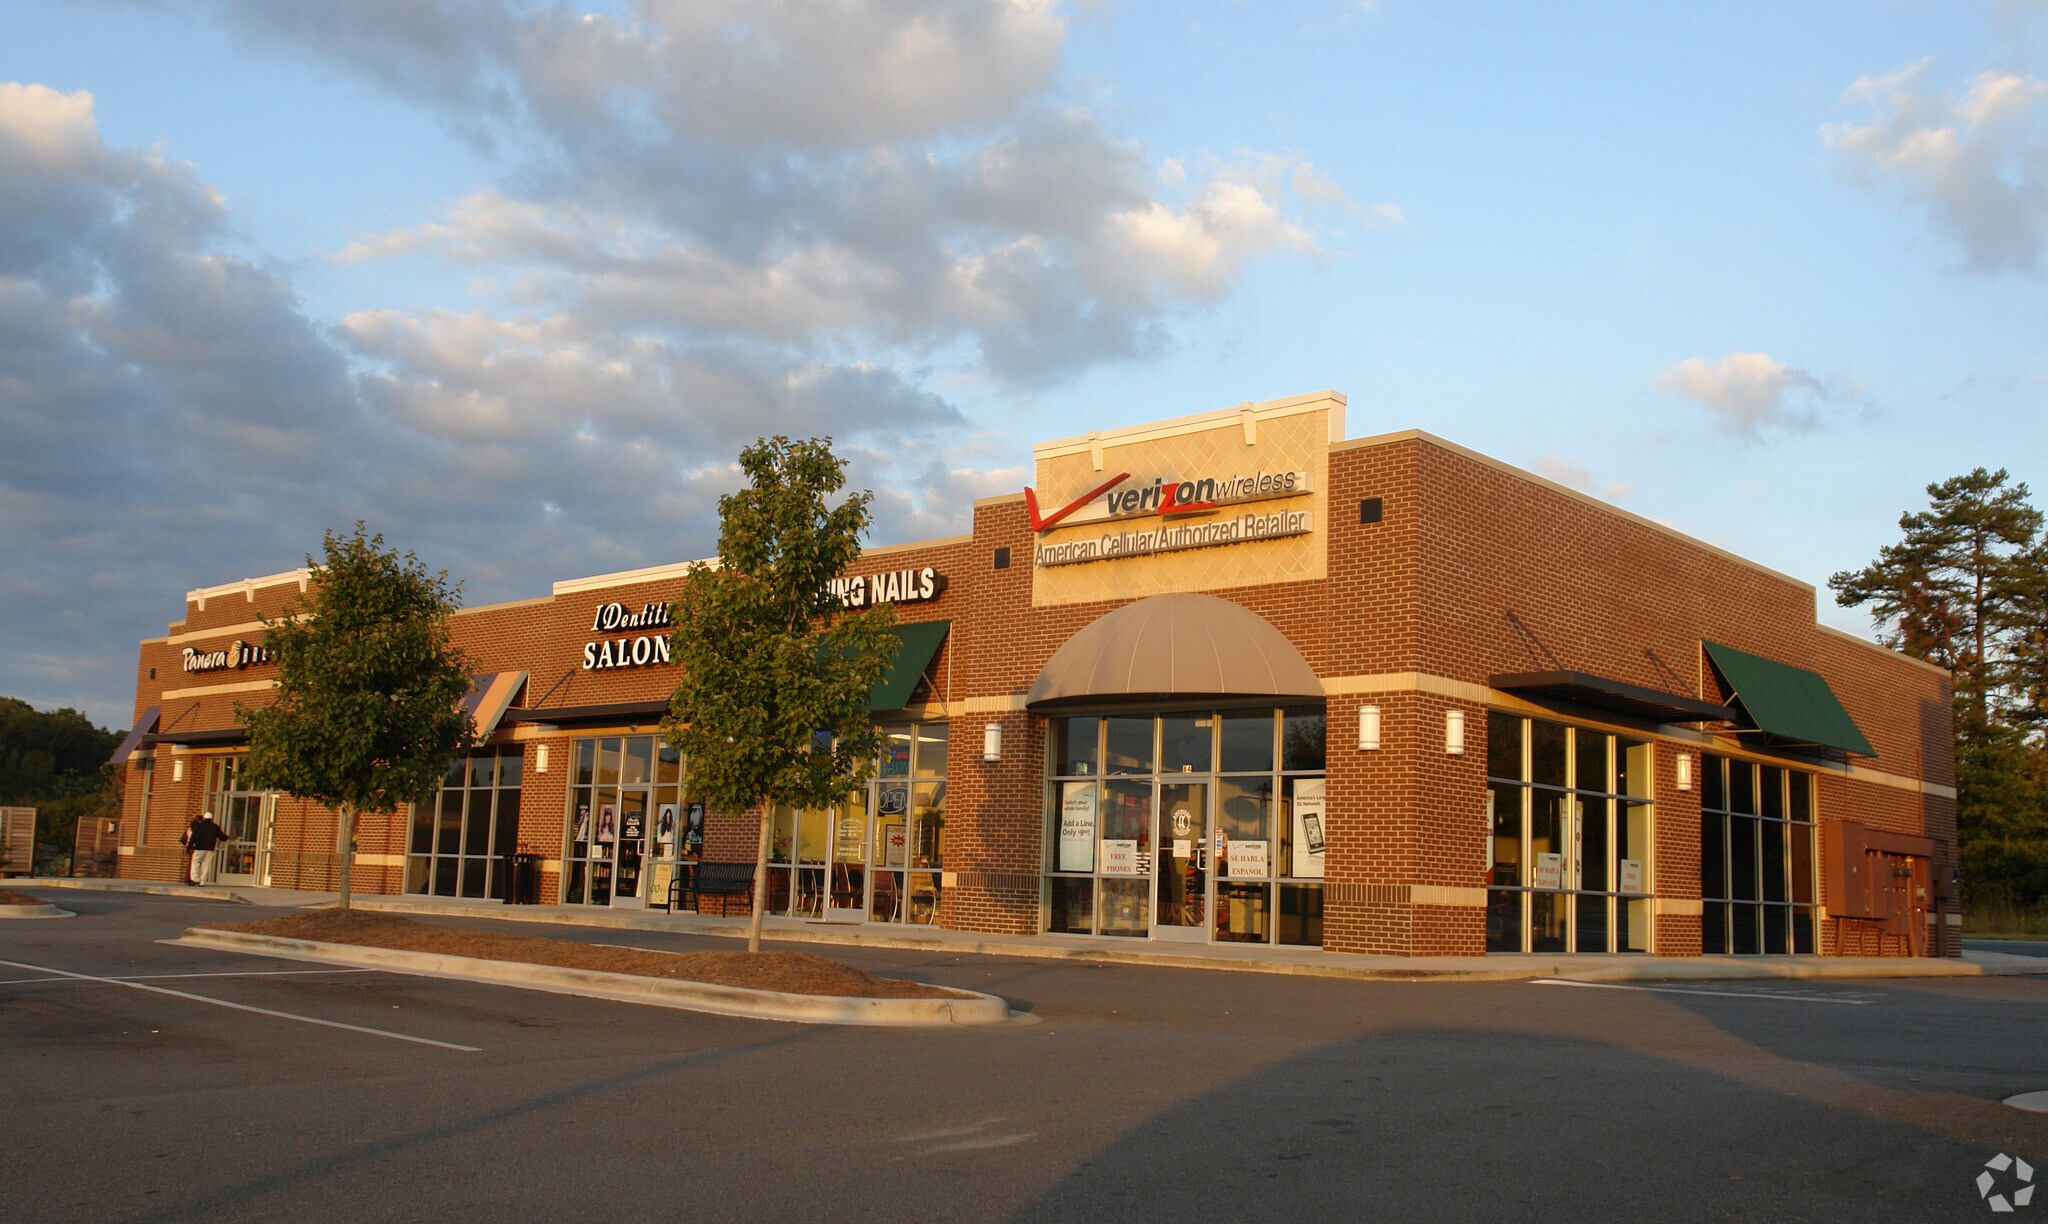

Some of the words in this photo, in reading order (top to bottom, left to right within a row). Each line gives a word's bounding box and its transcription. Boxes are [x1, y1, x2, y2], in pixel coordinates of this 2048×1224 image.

[1107, 477, 1218, 515] verizon
[1214, 470, 1296, 499] wireless
[1035, 539, 1097, 566] American
[1244, 508, 1305, 540] Retailer
[871, 567, 934, 604] NAILS
[182, 647, 226, 672] Panera
[583, 634, 671, 669] SALON
[879, 791, 908, 809] OPEN
[1062, 828, 1076, 838] Only
[1063, 819, 1074, 827] Add
